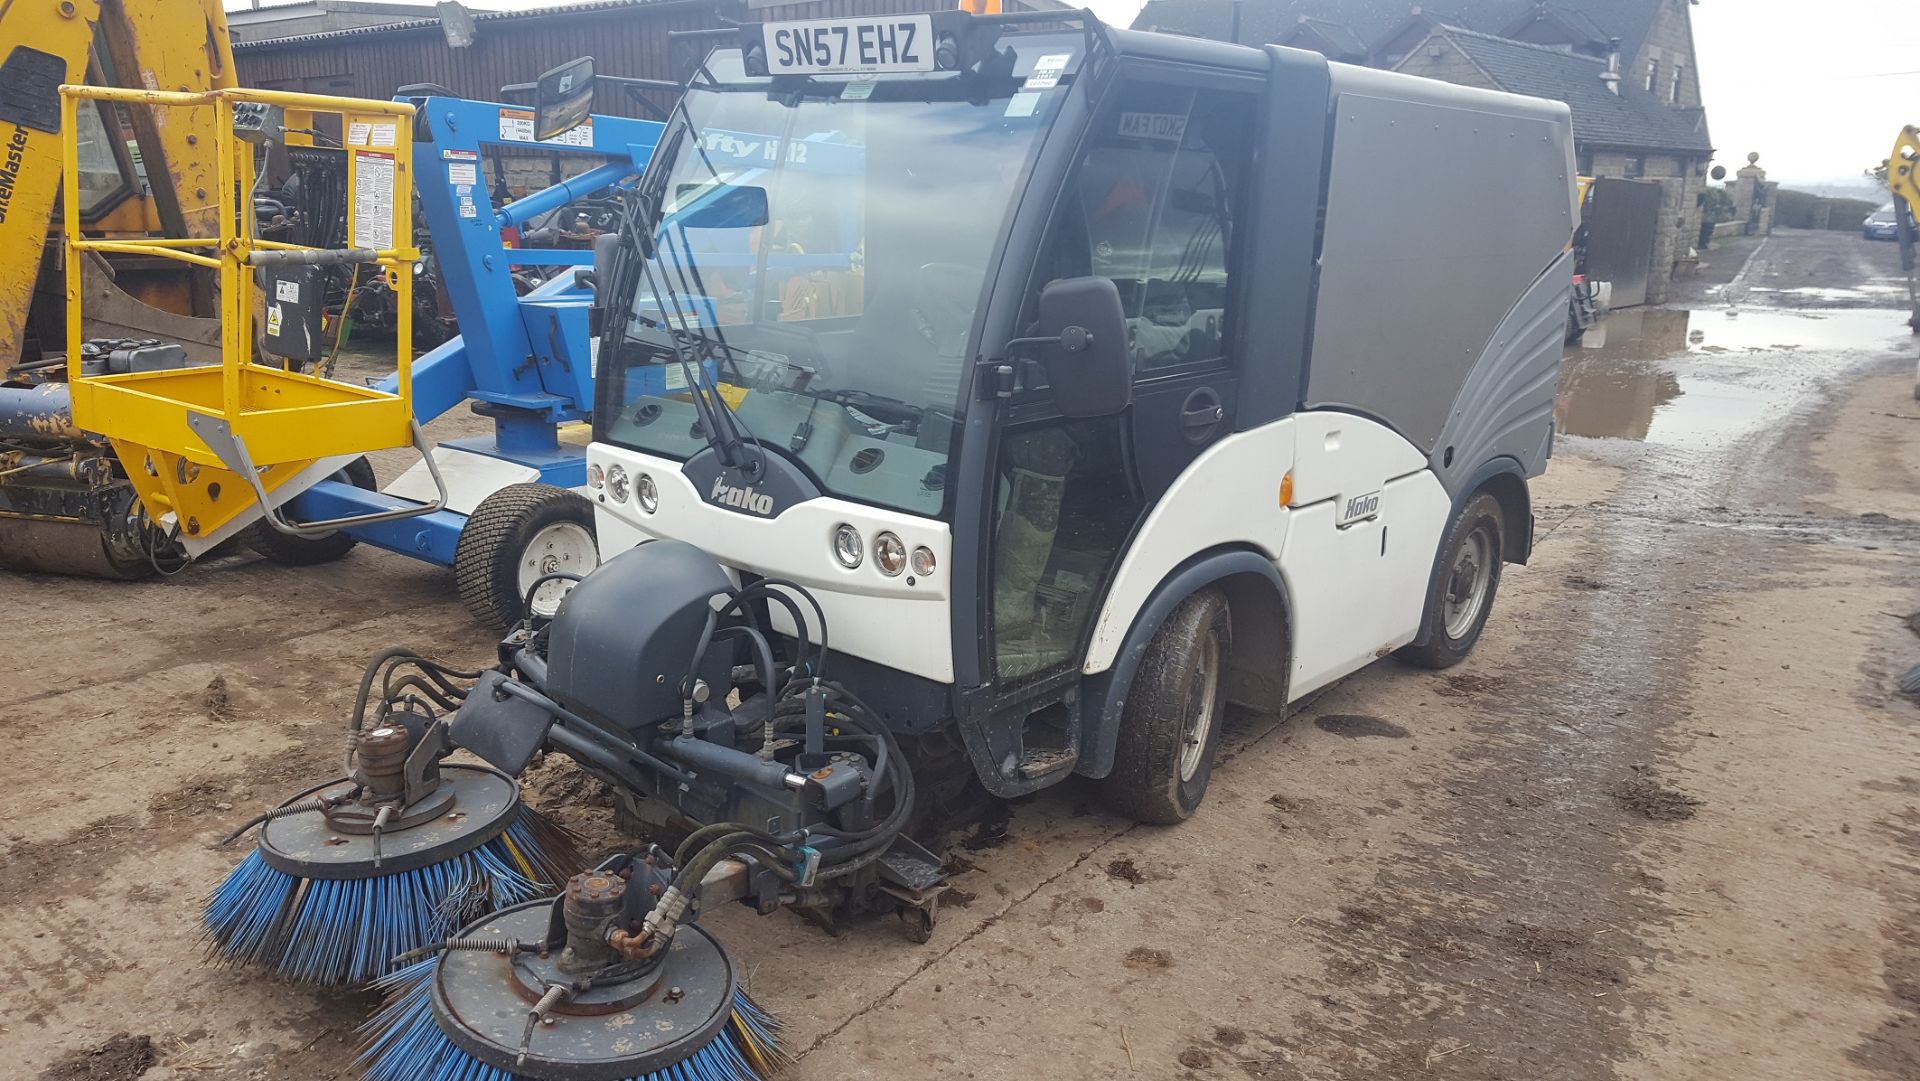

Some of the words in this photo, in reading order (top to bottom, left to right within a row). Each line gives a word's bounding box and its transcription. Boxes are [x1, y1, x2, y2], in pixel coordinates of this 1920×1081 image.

[775, 27, 848, 67] SN57
[857, 23, 919, 65] EHZ
[763, 140, 807, 163] H12
[1344, 493, 1379, 520] Hako
